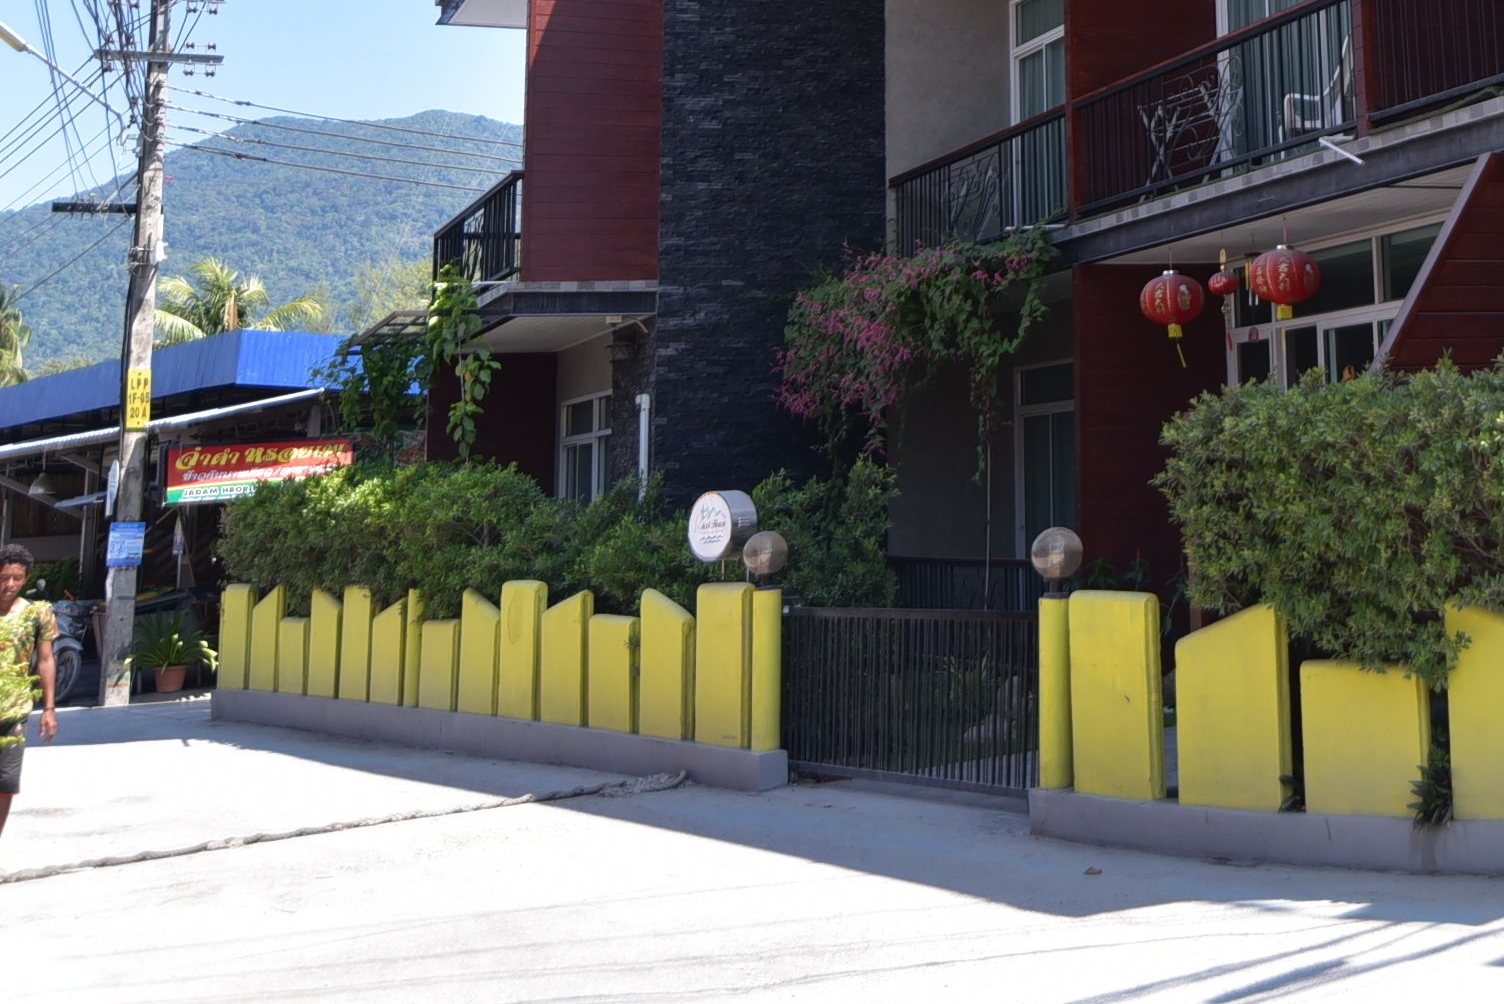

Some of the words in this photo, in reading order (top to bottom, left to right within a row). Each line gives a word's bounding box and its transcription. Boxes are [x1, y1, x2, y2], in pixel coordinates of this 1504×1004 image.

[129, 392, 150, 404] 1F-05
[130, 407, 140, 418] 20
[142, 406, 147, 417] A
[183, 486, 218, 496] JADAM
